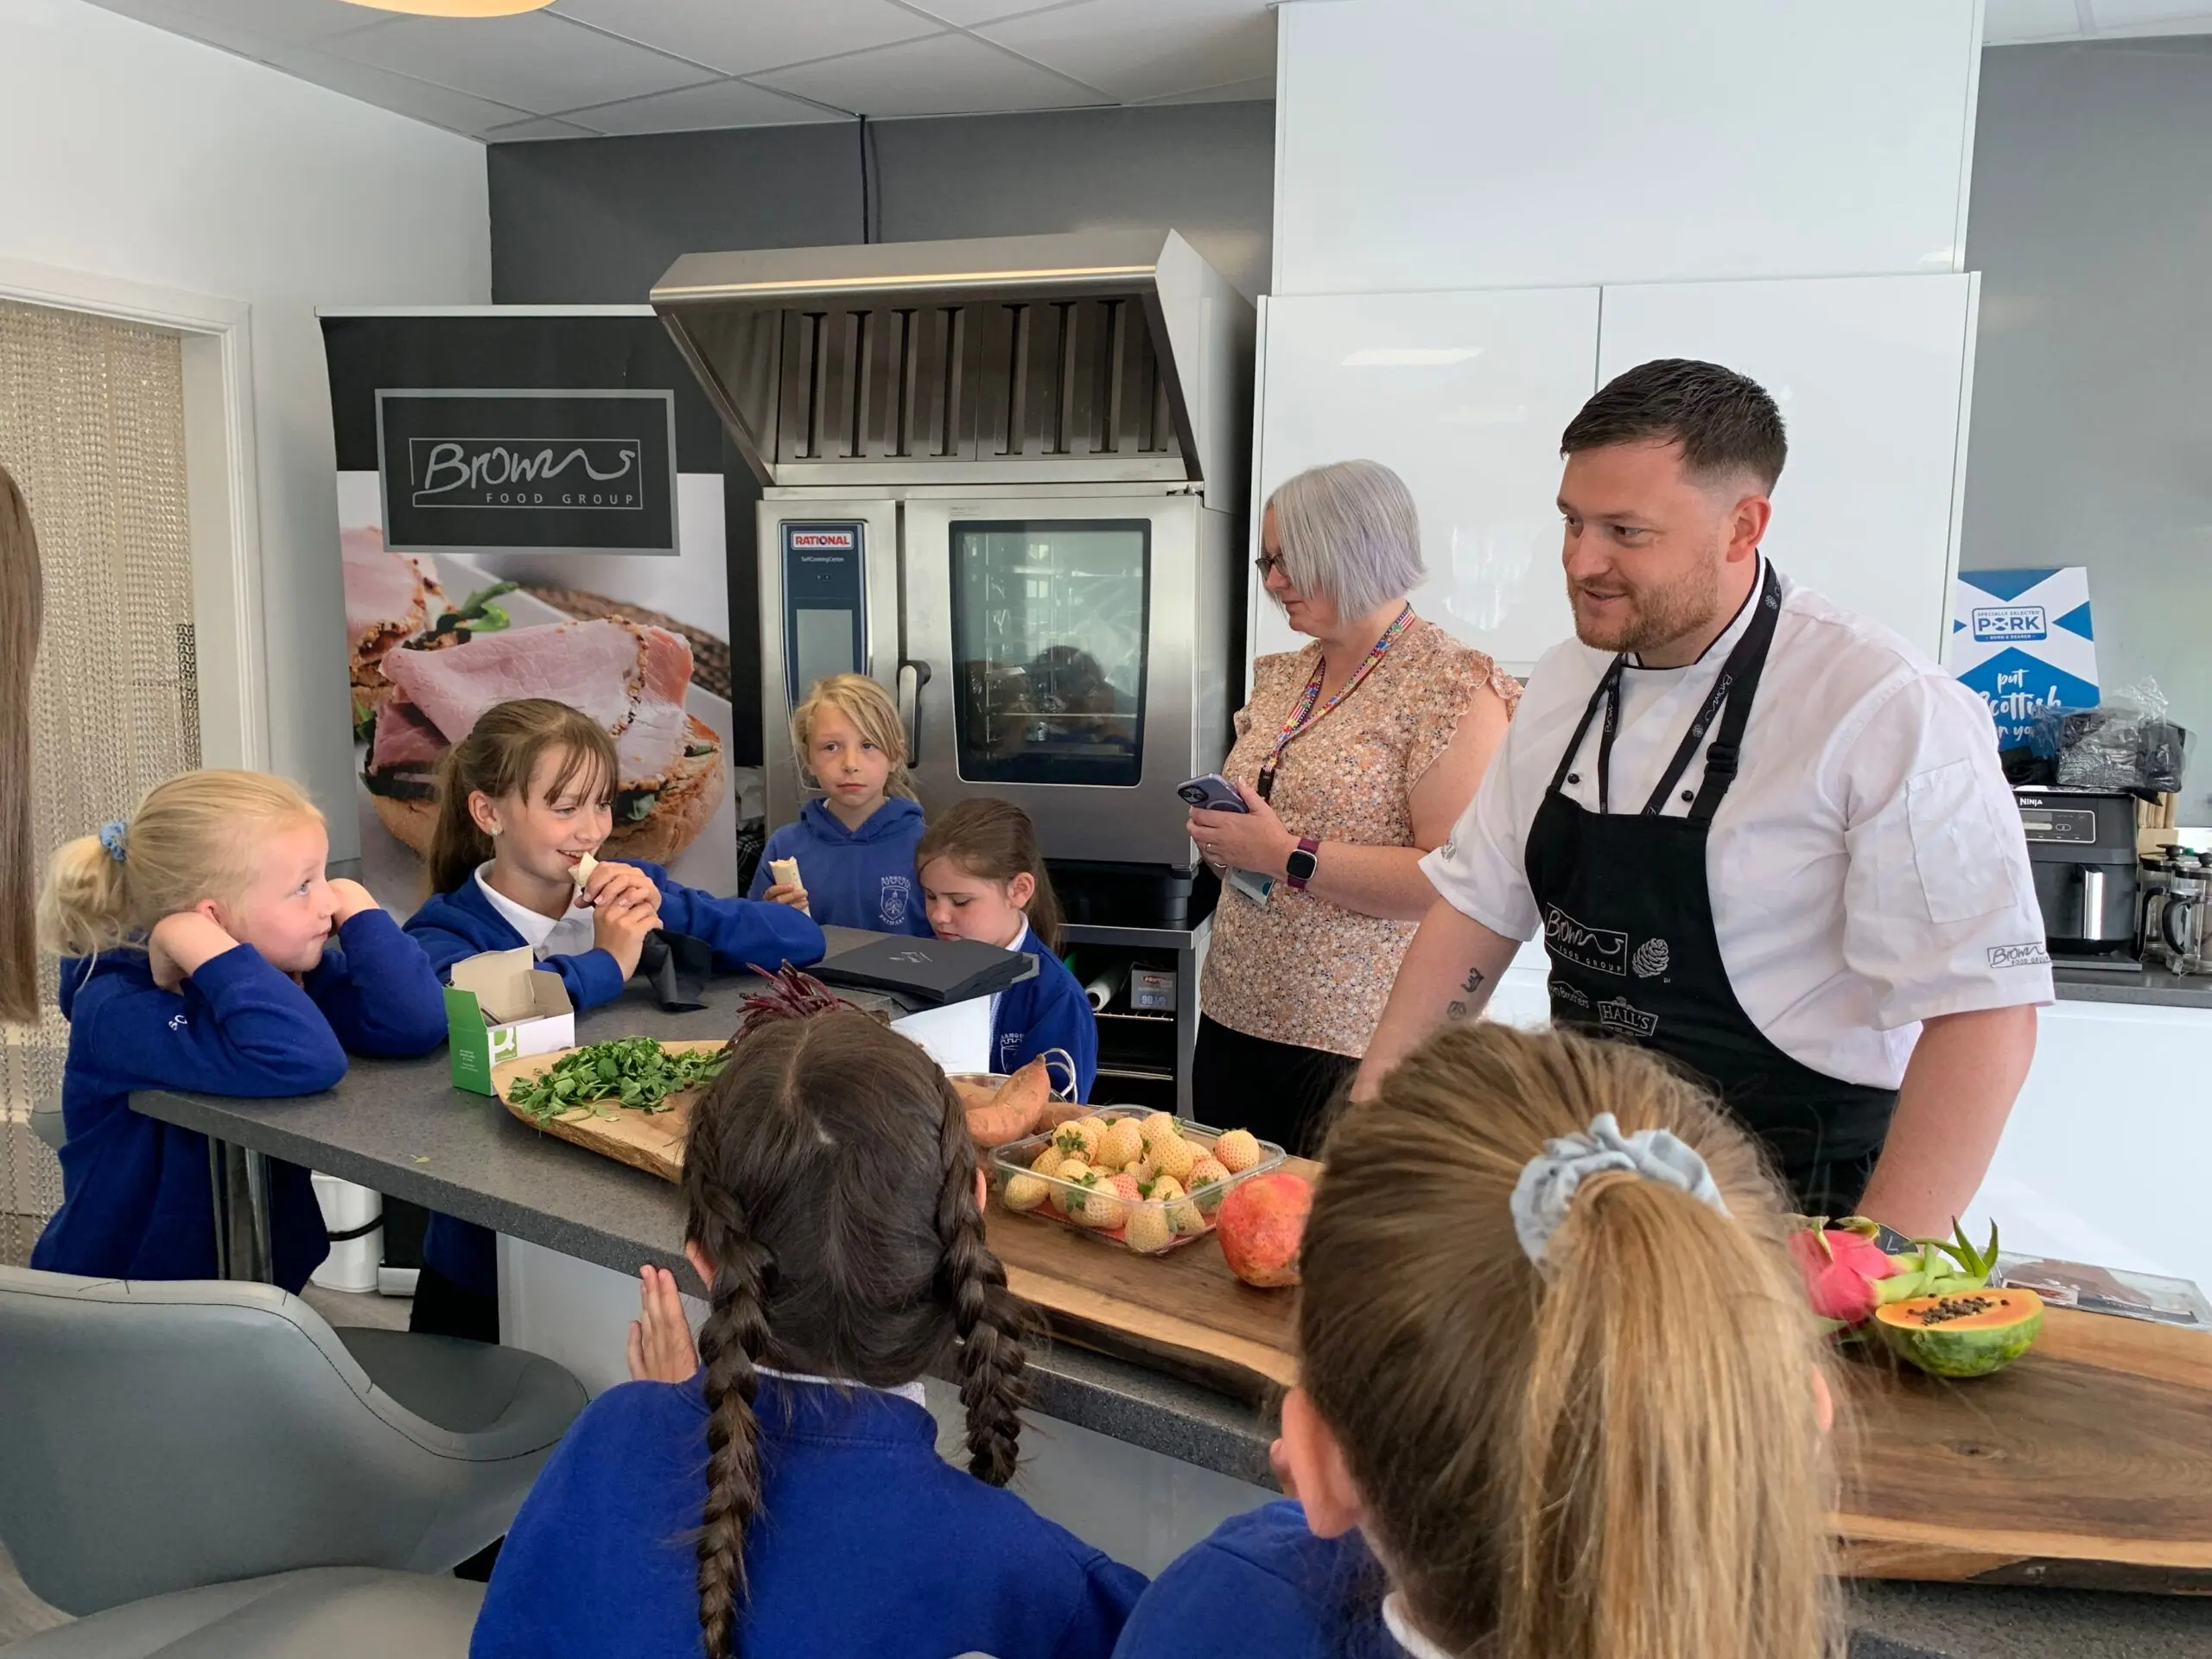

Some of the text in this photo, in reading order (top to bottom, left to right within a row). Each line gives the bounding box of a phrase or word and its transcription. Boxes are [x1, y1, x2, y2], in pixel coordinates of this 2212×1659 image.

[486, 493, 633, 505] FOOD GROUP
[795, 536, 850, 545] RATIONAL
[1997, 669, 2030, 695] put
[2019, 797, 2043, 807] NINJA
[1586, 957, 1622, 972] GROUP
[1602, 1004, 1650, 1030] HALL'S
